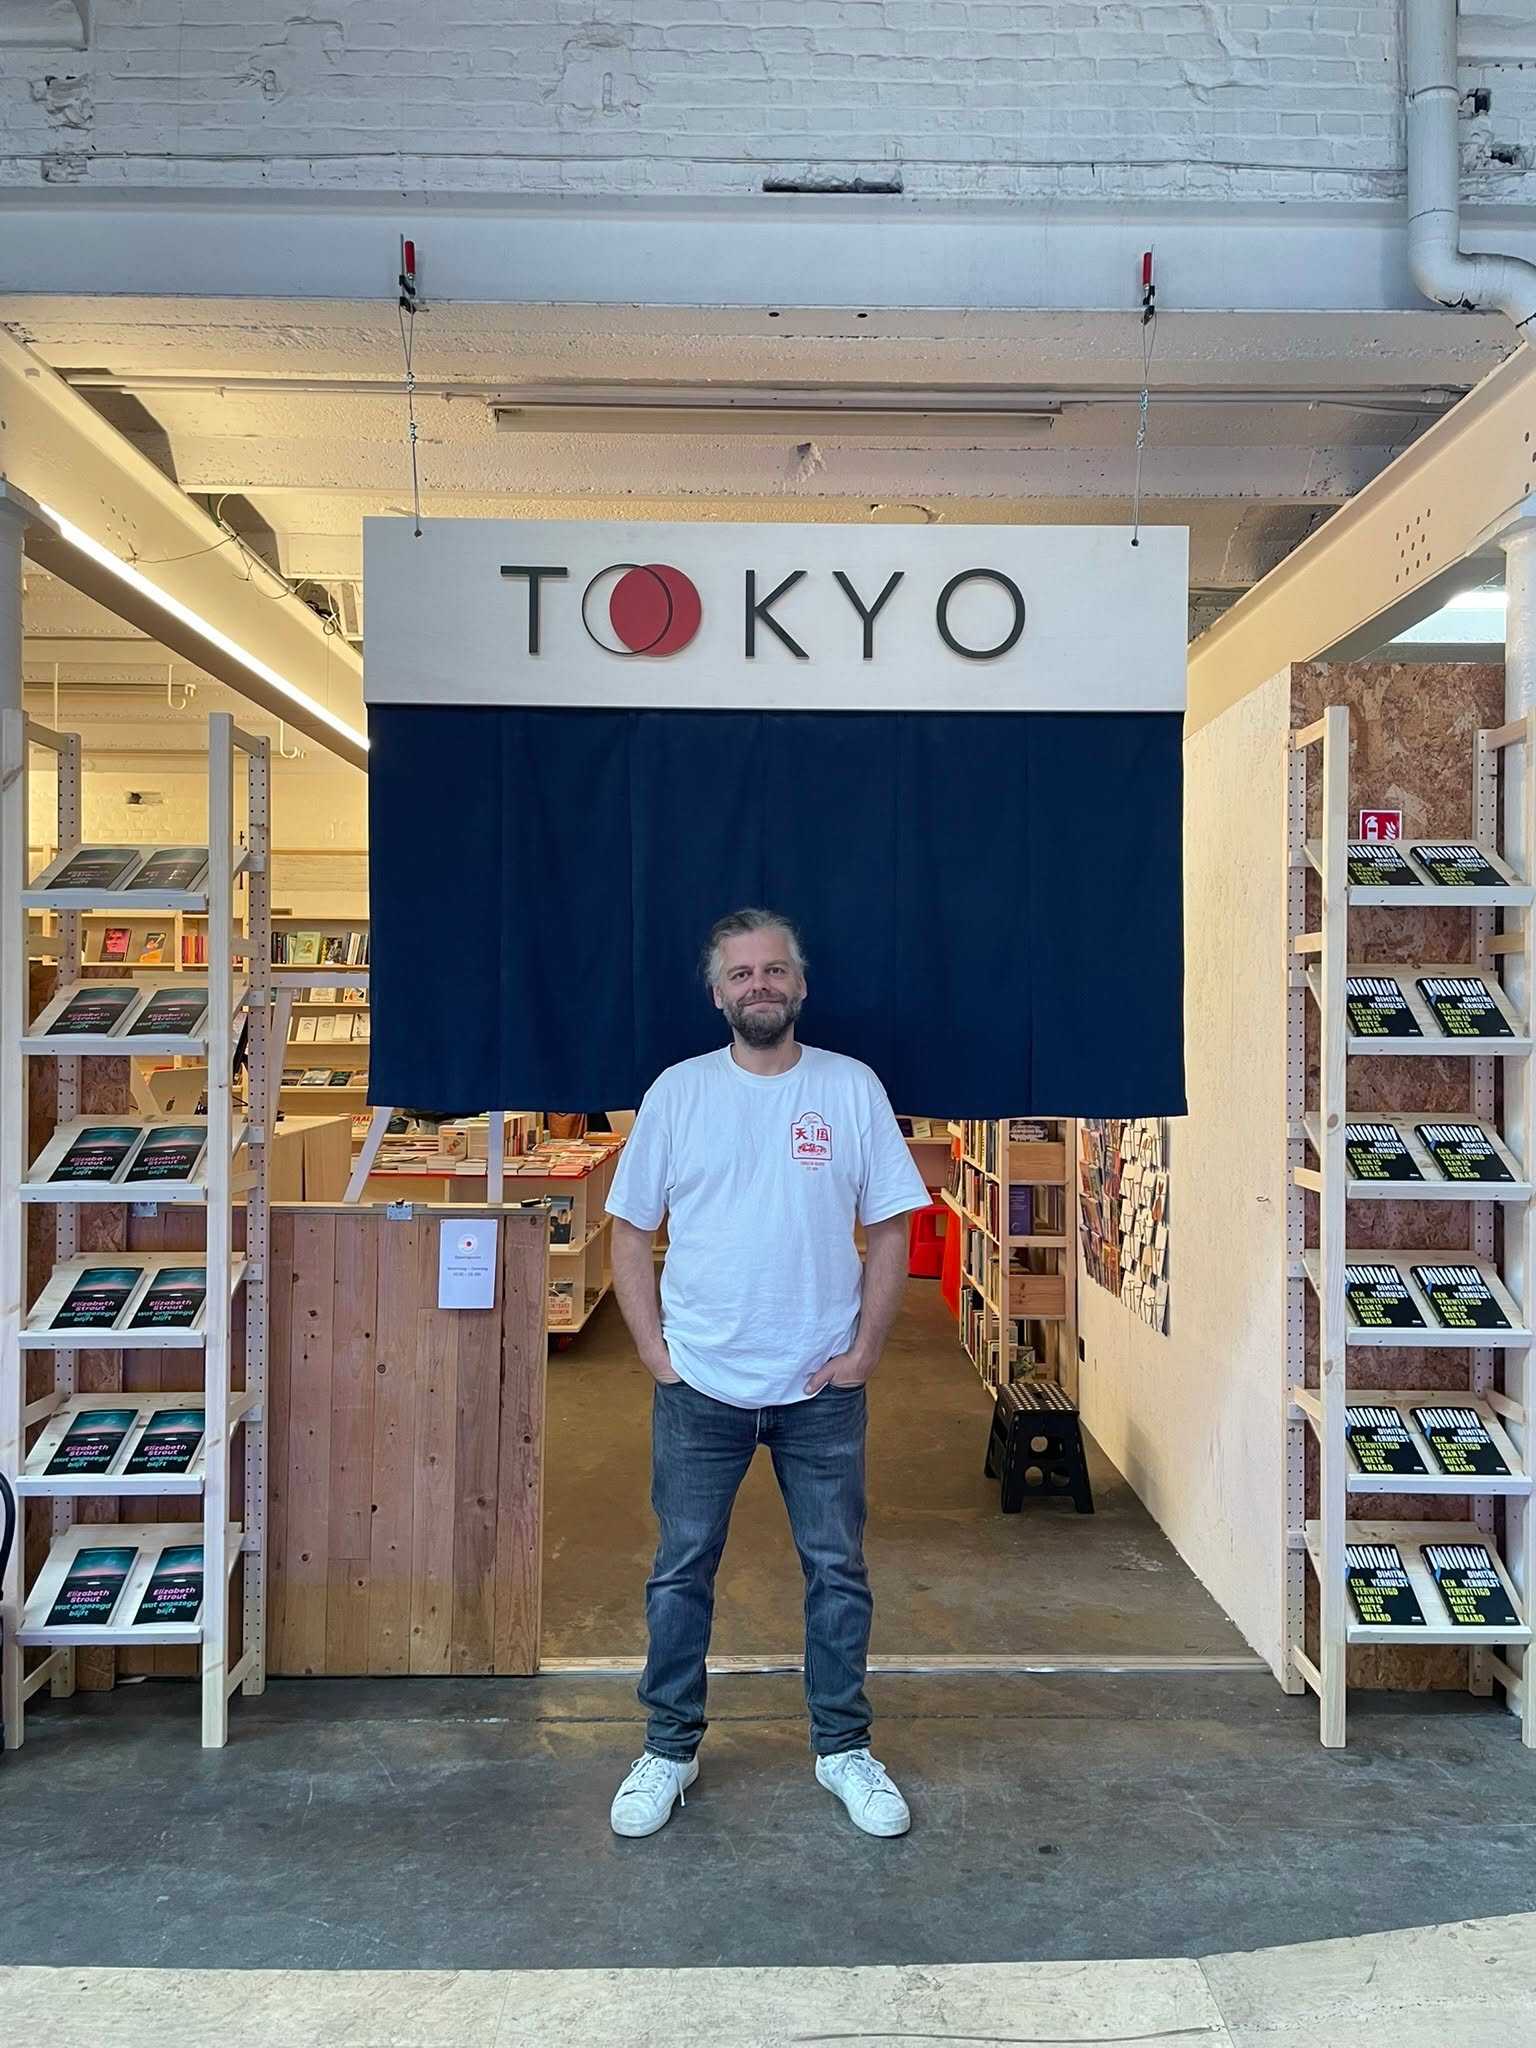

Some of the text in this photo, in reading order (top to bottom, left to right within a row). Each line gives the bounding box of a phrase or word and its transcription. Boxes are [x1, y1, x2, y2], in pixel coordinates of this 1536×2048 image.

[499, 563, 1027, 661] TOKYO
[795, 1128, 808, 1140] 天
[1371, 1579, 1408, 1587] VERHULST
[1462, 1579, 1500, 1587] VERHULST
[153, 1588, 196, 1596] Elizabeth
[1357, 1596, 1373, 1604] MAN
[1363, 1614, 1391, 1622] WAARD
